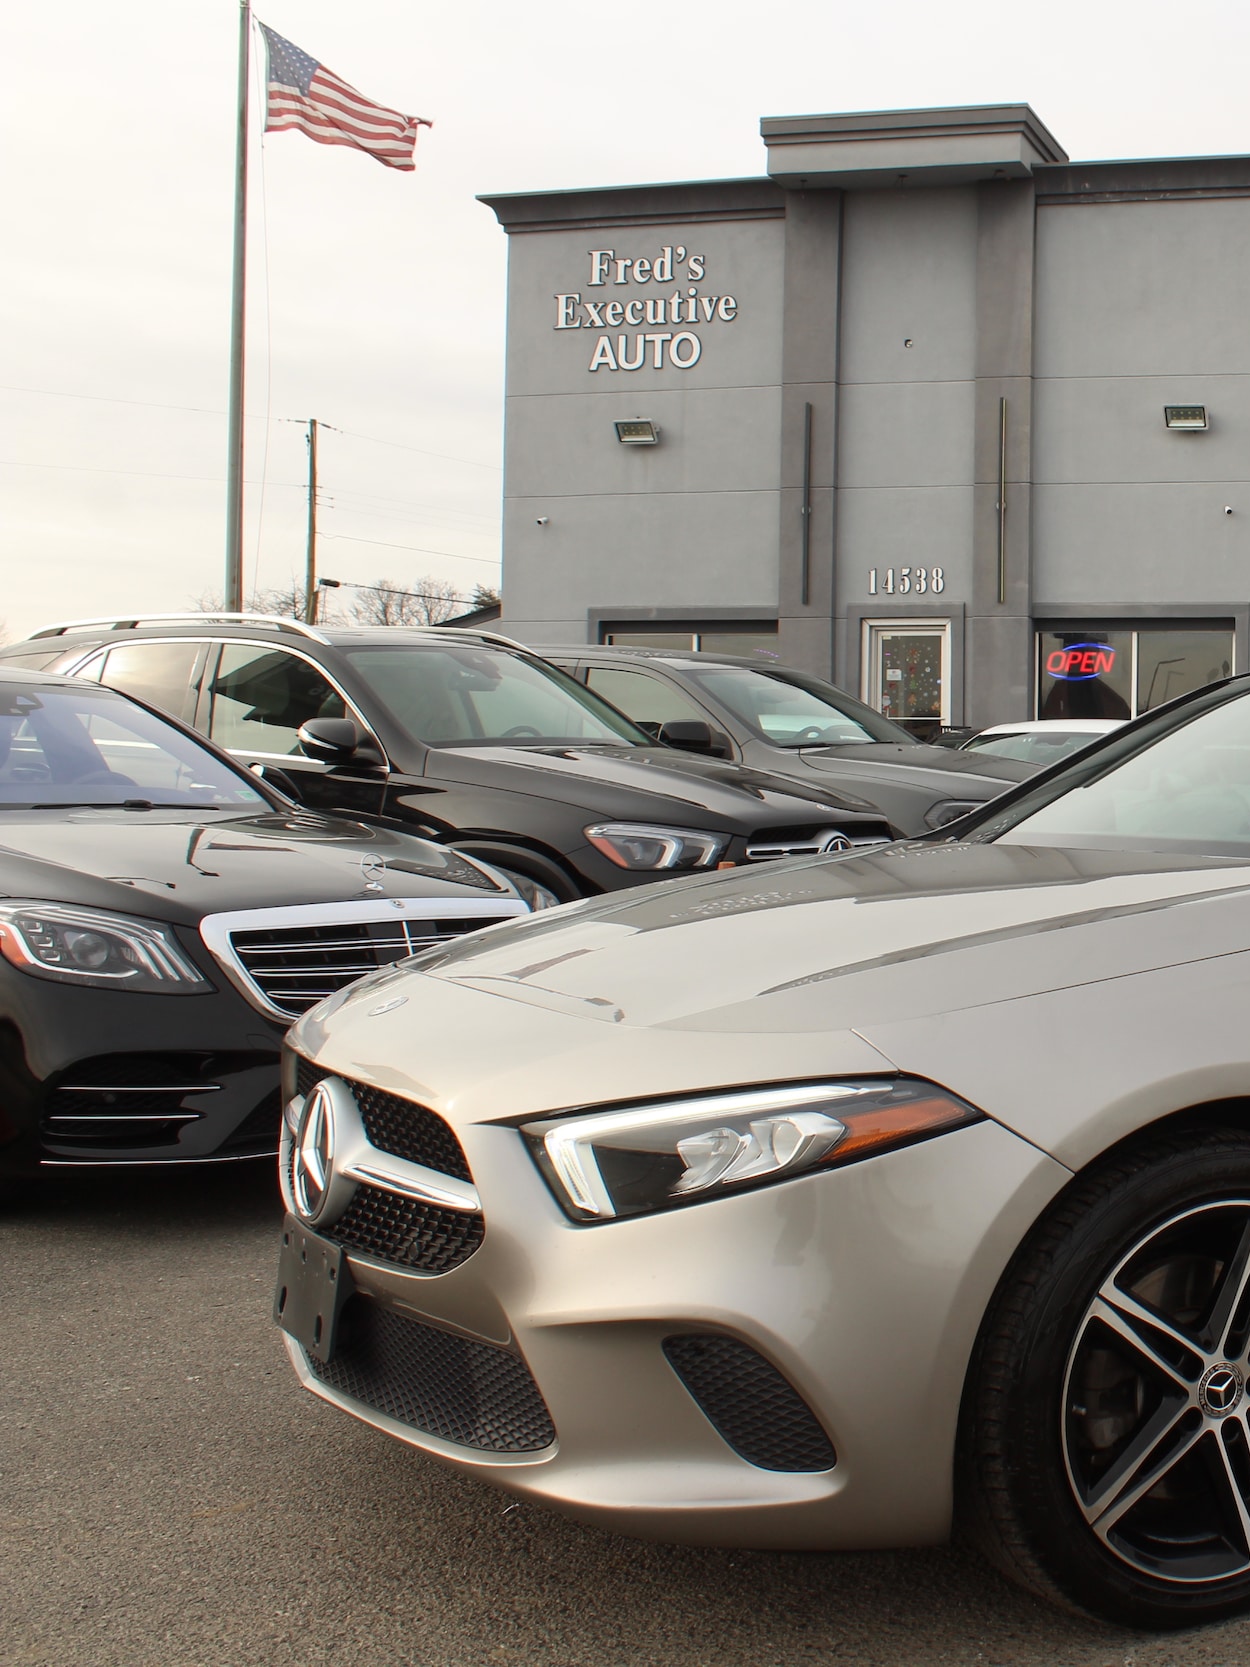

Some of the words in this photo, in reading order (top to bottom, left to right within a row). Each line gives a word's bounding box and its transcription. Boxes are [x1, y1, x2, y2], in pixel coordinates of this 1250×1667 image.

[587, 245, 706, 287] Fred's
[553, 286, 738, 330] Executive
[588, 330, 703, 372] AUTO
[867, 566, 946, 595] 14538
[1045, 650, 1116, 674] OPEN
